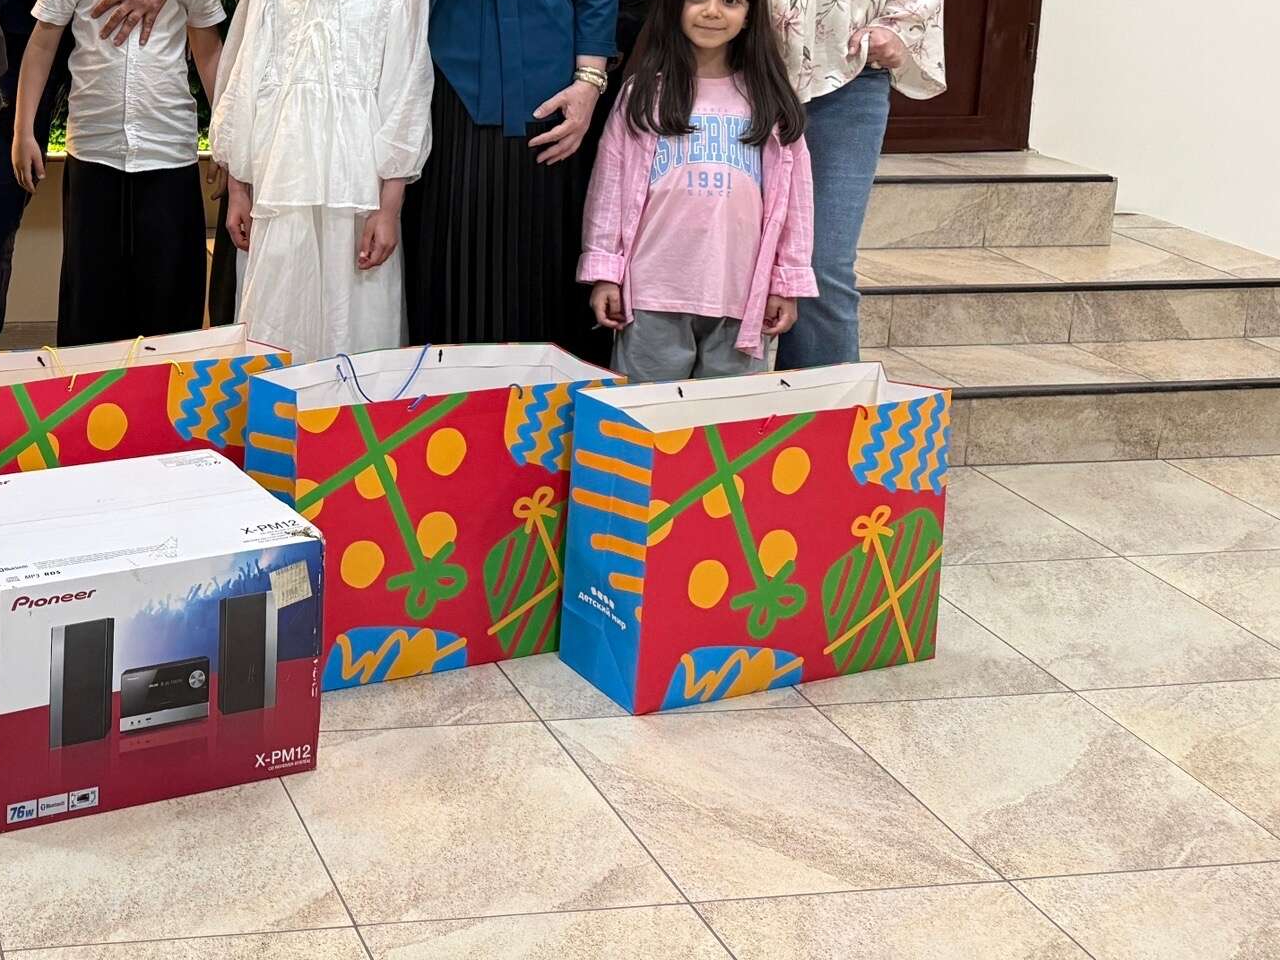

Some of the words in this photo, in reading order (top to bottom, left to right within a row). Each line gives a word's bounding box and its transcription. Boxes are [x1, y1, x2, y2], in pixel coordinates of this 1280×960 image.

[687, 170, 732, 189] 1991
[240, 519, 300, 535] X-PM12
[11, 589, 97, 611] Pioneer
[255, 744, 311, 768] X-PM12
